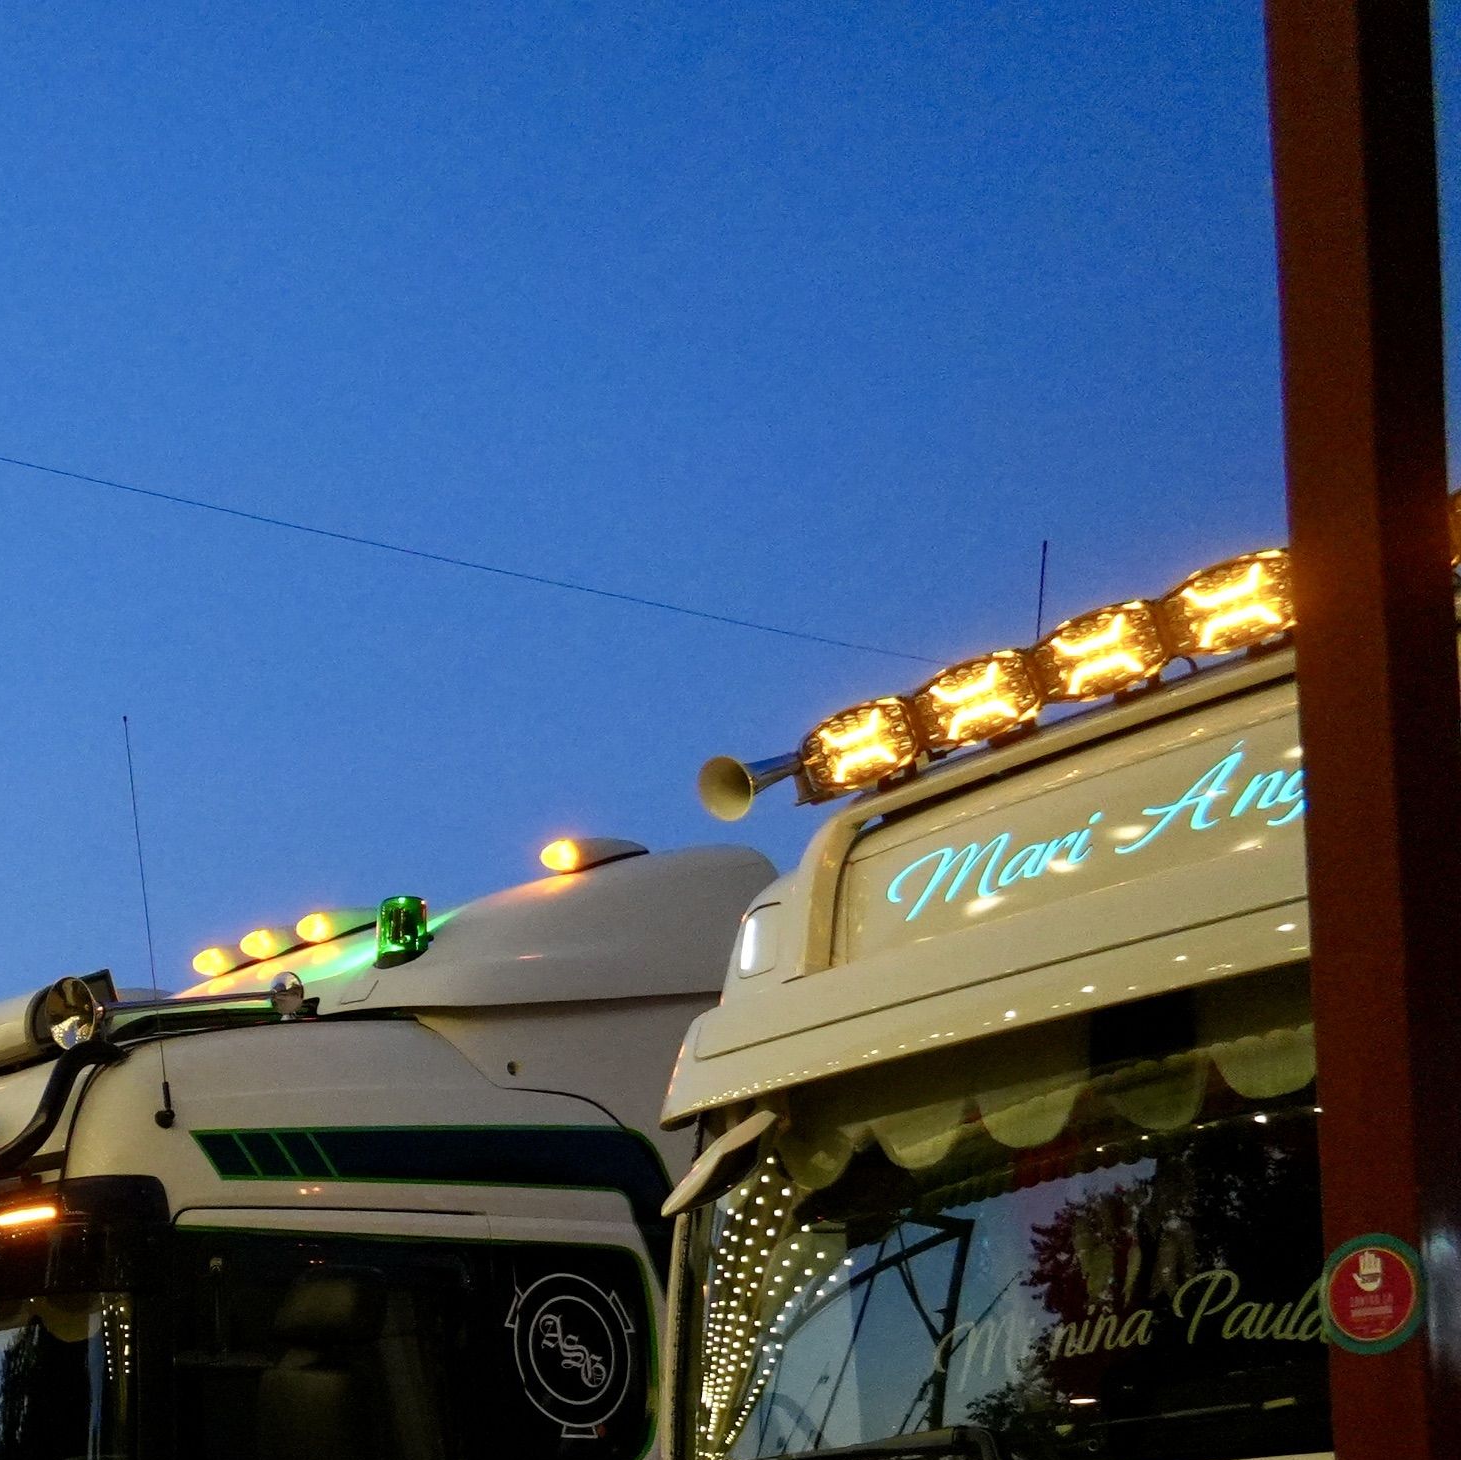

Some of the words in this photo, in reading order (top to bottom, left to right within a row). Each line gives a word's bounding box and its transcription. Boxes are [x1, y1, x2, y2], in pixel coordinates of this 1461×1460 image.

[887, 812, 1104, 922] Mari
[1114, 740, 1308, 854] Áng
[1049, 1304, 1154, 1362] niña
